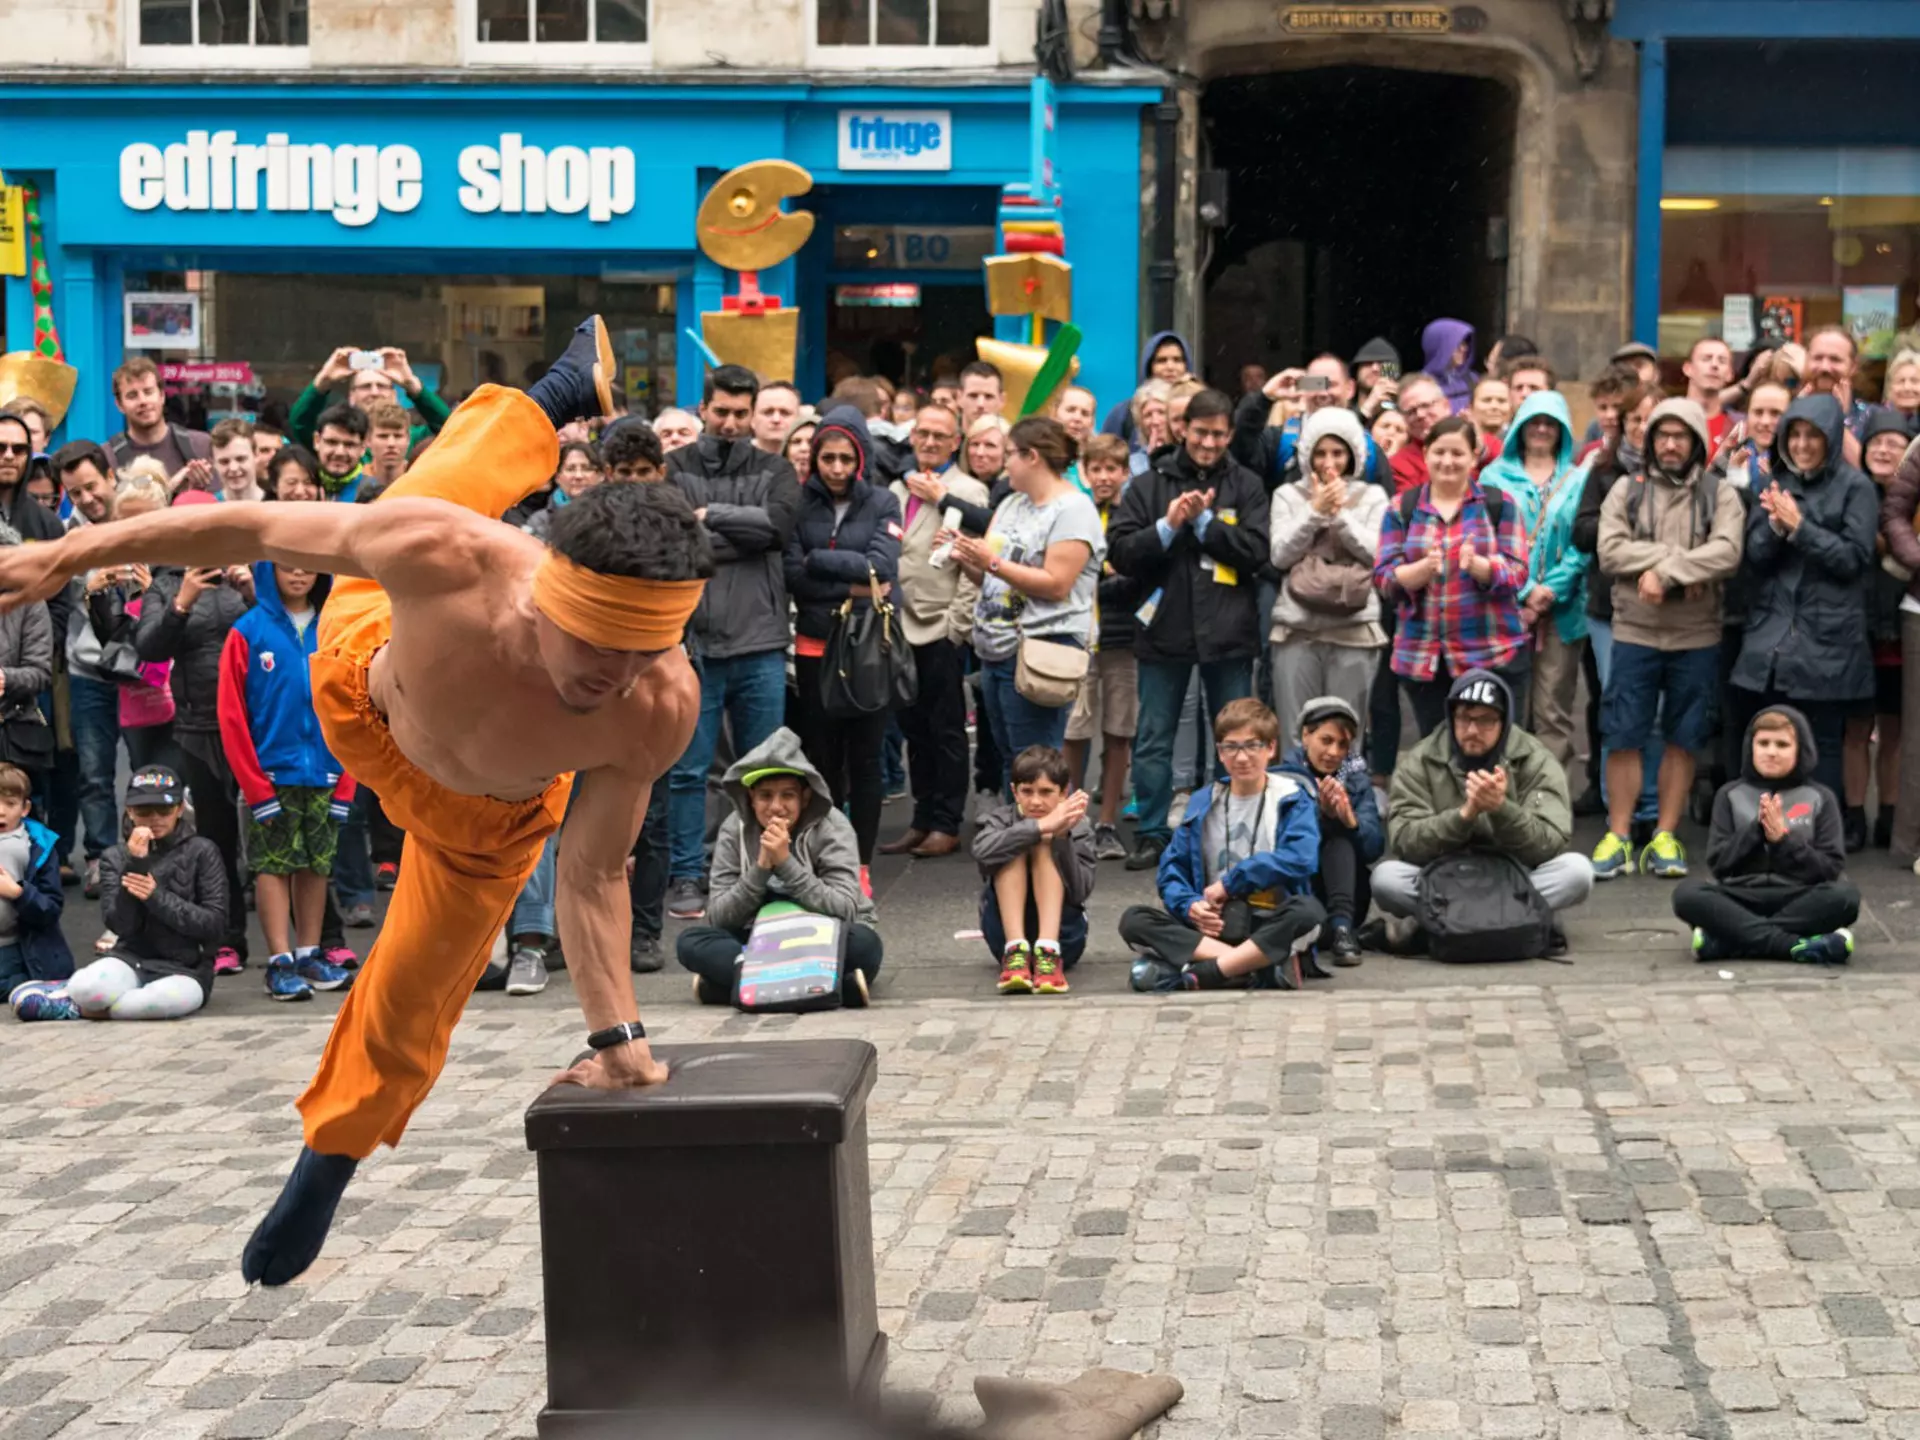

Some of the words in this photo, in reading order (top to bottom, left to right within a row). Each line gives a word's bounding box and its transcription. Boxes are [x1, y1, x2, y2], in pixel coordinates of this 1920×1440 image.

[1391, 13, 1441, 28] CLOSE
[849, 115, 941, 156] fringe
[119, 130, 423, 227] edfringe
[458, 132, 635, 222] shop
[179, 366, 214, 381] August
[216, 366, 243, 380] 2016
